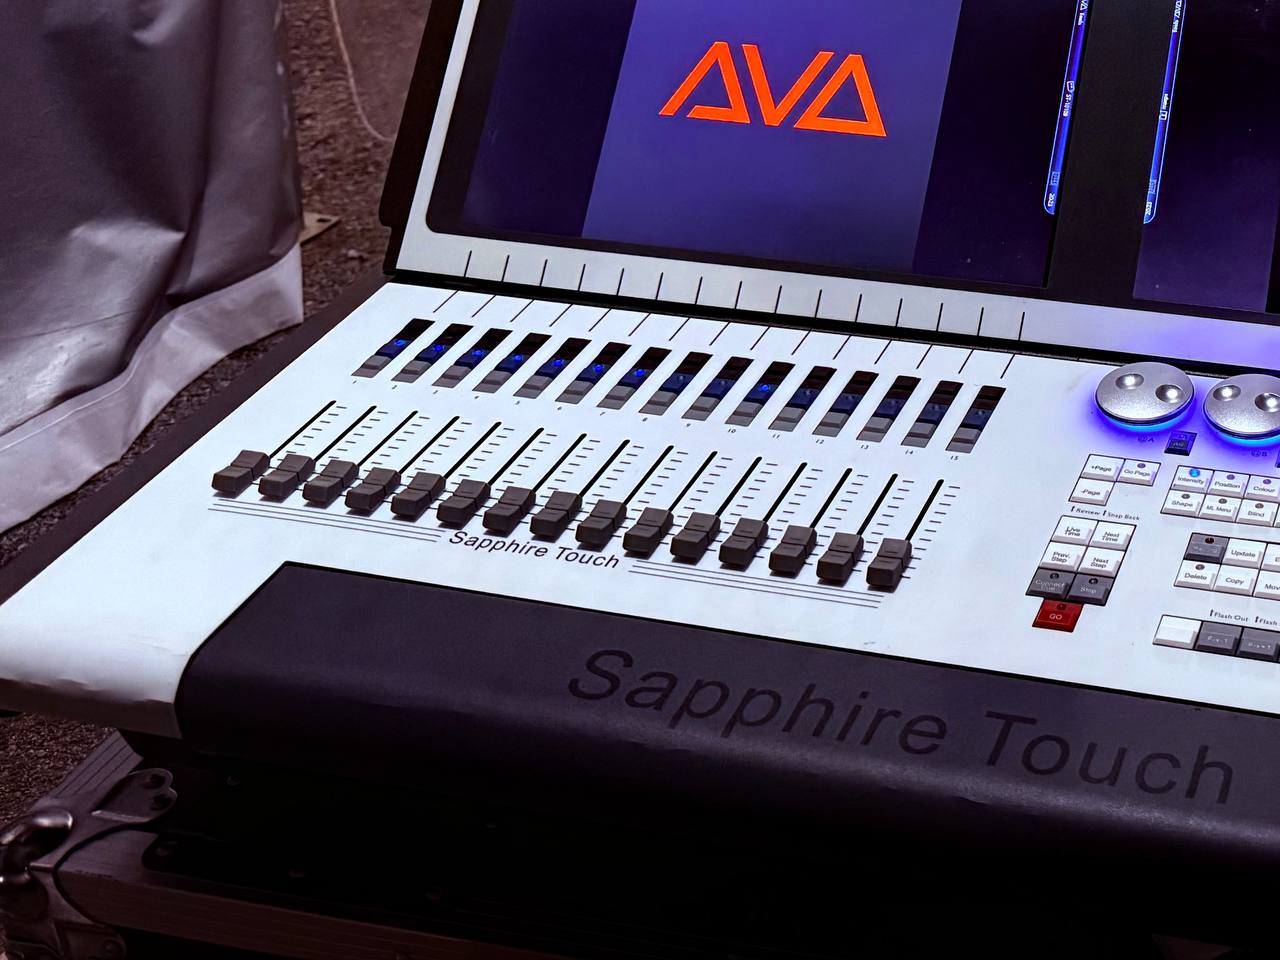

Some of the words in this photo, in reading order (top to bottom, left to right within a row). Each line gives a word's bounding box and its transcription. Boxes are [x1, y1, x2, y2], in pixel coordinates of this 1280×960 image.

[1178, 476, 1204, 485] Intensity
[1254, 484, 1275, 493] Colour
[1172, 500, 1193, 508] Shape
[450, 531, 548, 557] Sapphire
[555, 547, 619, 568] Touch
[1231, 550, 1256, 558] Update
[1184, 573, 1207, 581] Delete
[1225, 577, 1244, 585] Copy
[1214, 612, 1232, 620] Flash
[1259, 618, 1277, 626] Flash
[568, 649, 949, 757] Sapphire
[983, 710, 1236, 806] Touch
